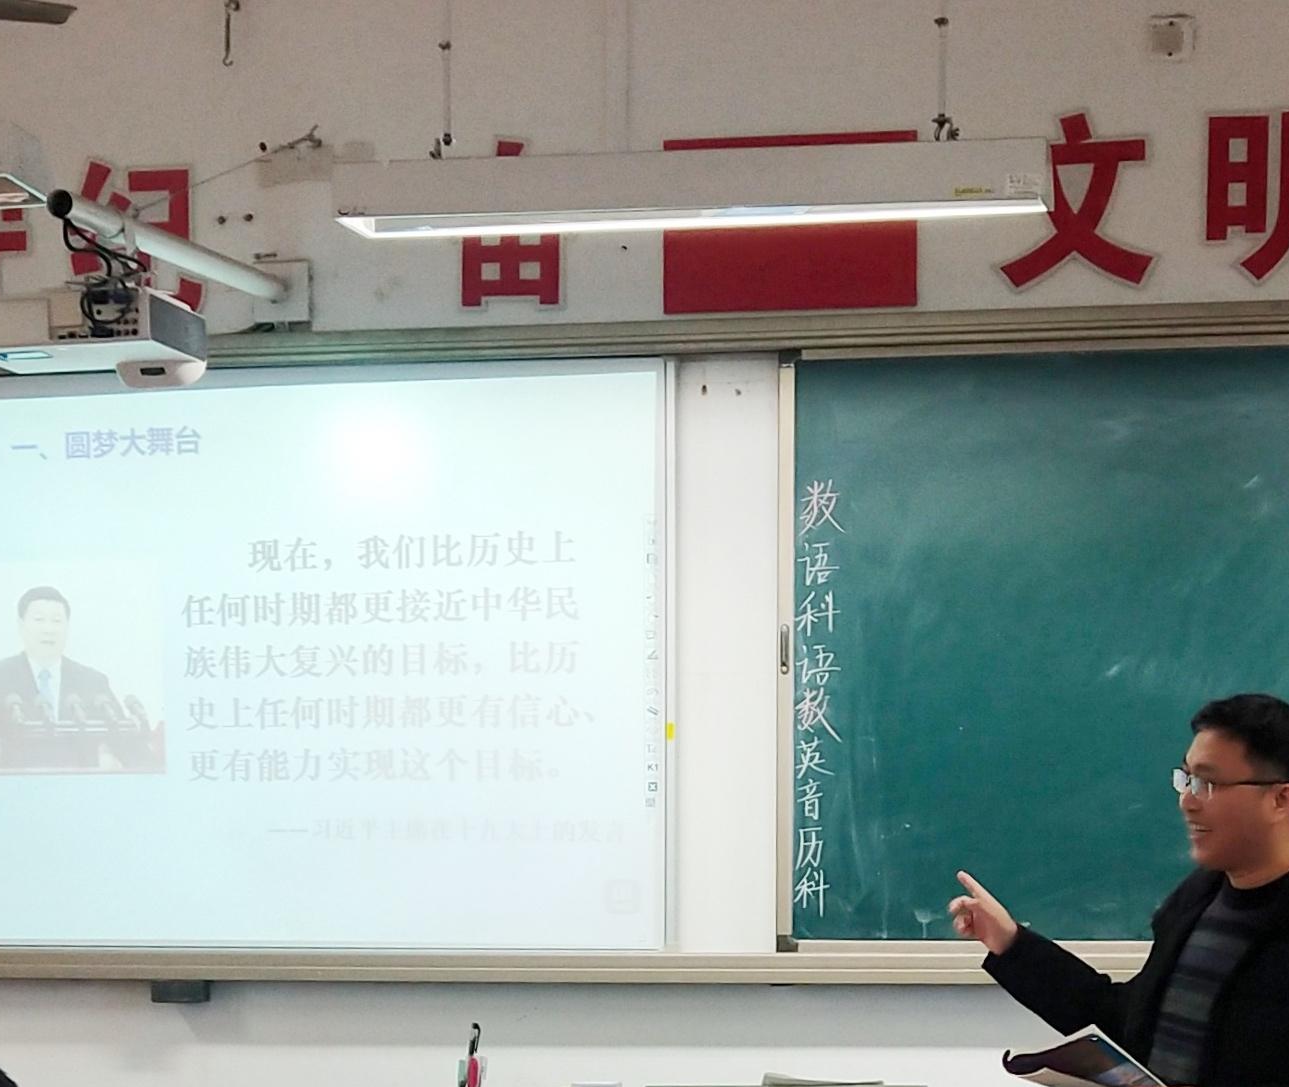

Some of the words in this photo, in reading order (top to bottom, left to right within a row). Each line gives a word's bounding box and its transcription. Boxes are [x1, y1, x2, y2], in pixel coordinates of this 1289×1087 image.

[11, 426, 202, 460] 一、圆梦大舞台
[247, 530, 577, 573] 现在，我们比历史上
[181, 586, 580, 627] 任何时期都更接近中华民
[184, 639, 581, 680] 族伟大复兴的目标，比历
[185, 694, 599, 732] 史上任何时期都更有信心、
[189, 748, 561, 784] 更有能力实现这个目标。
